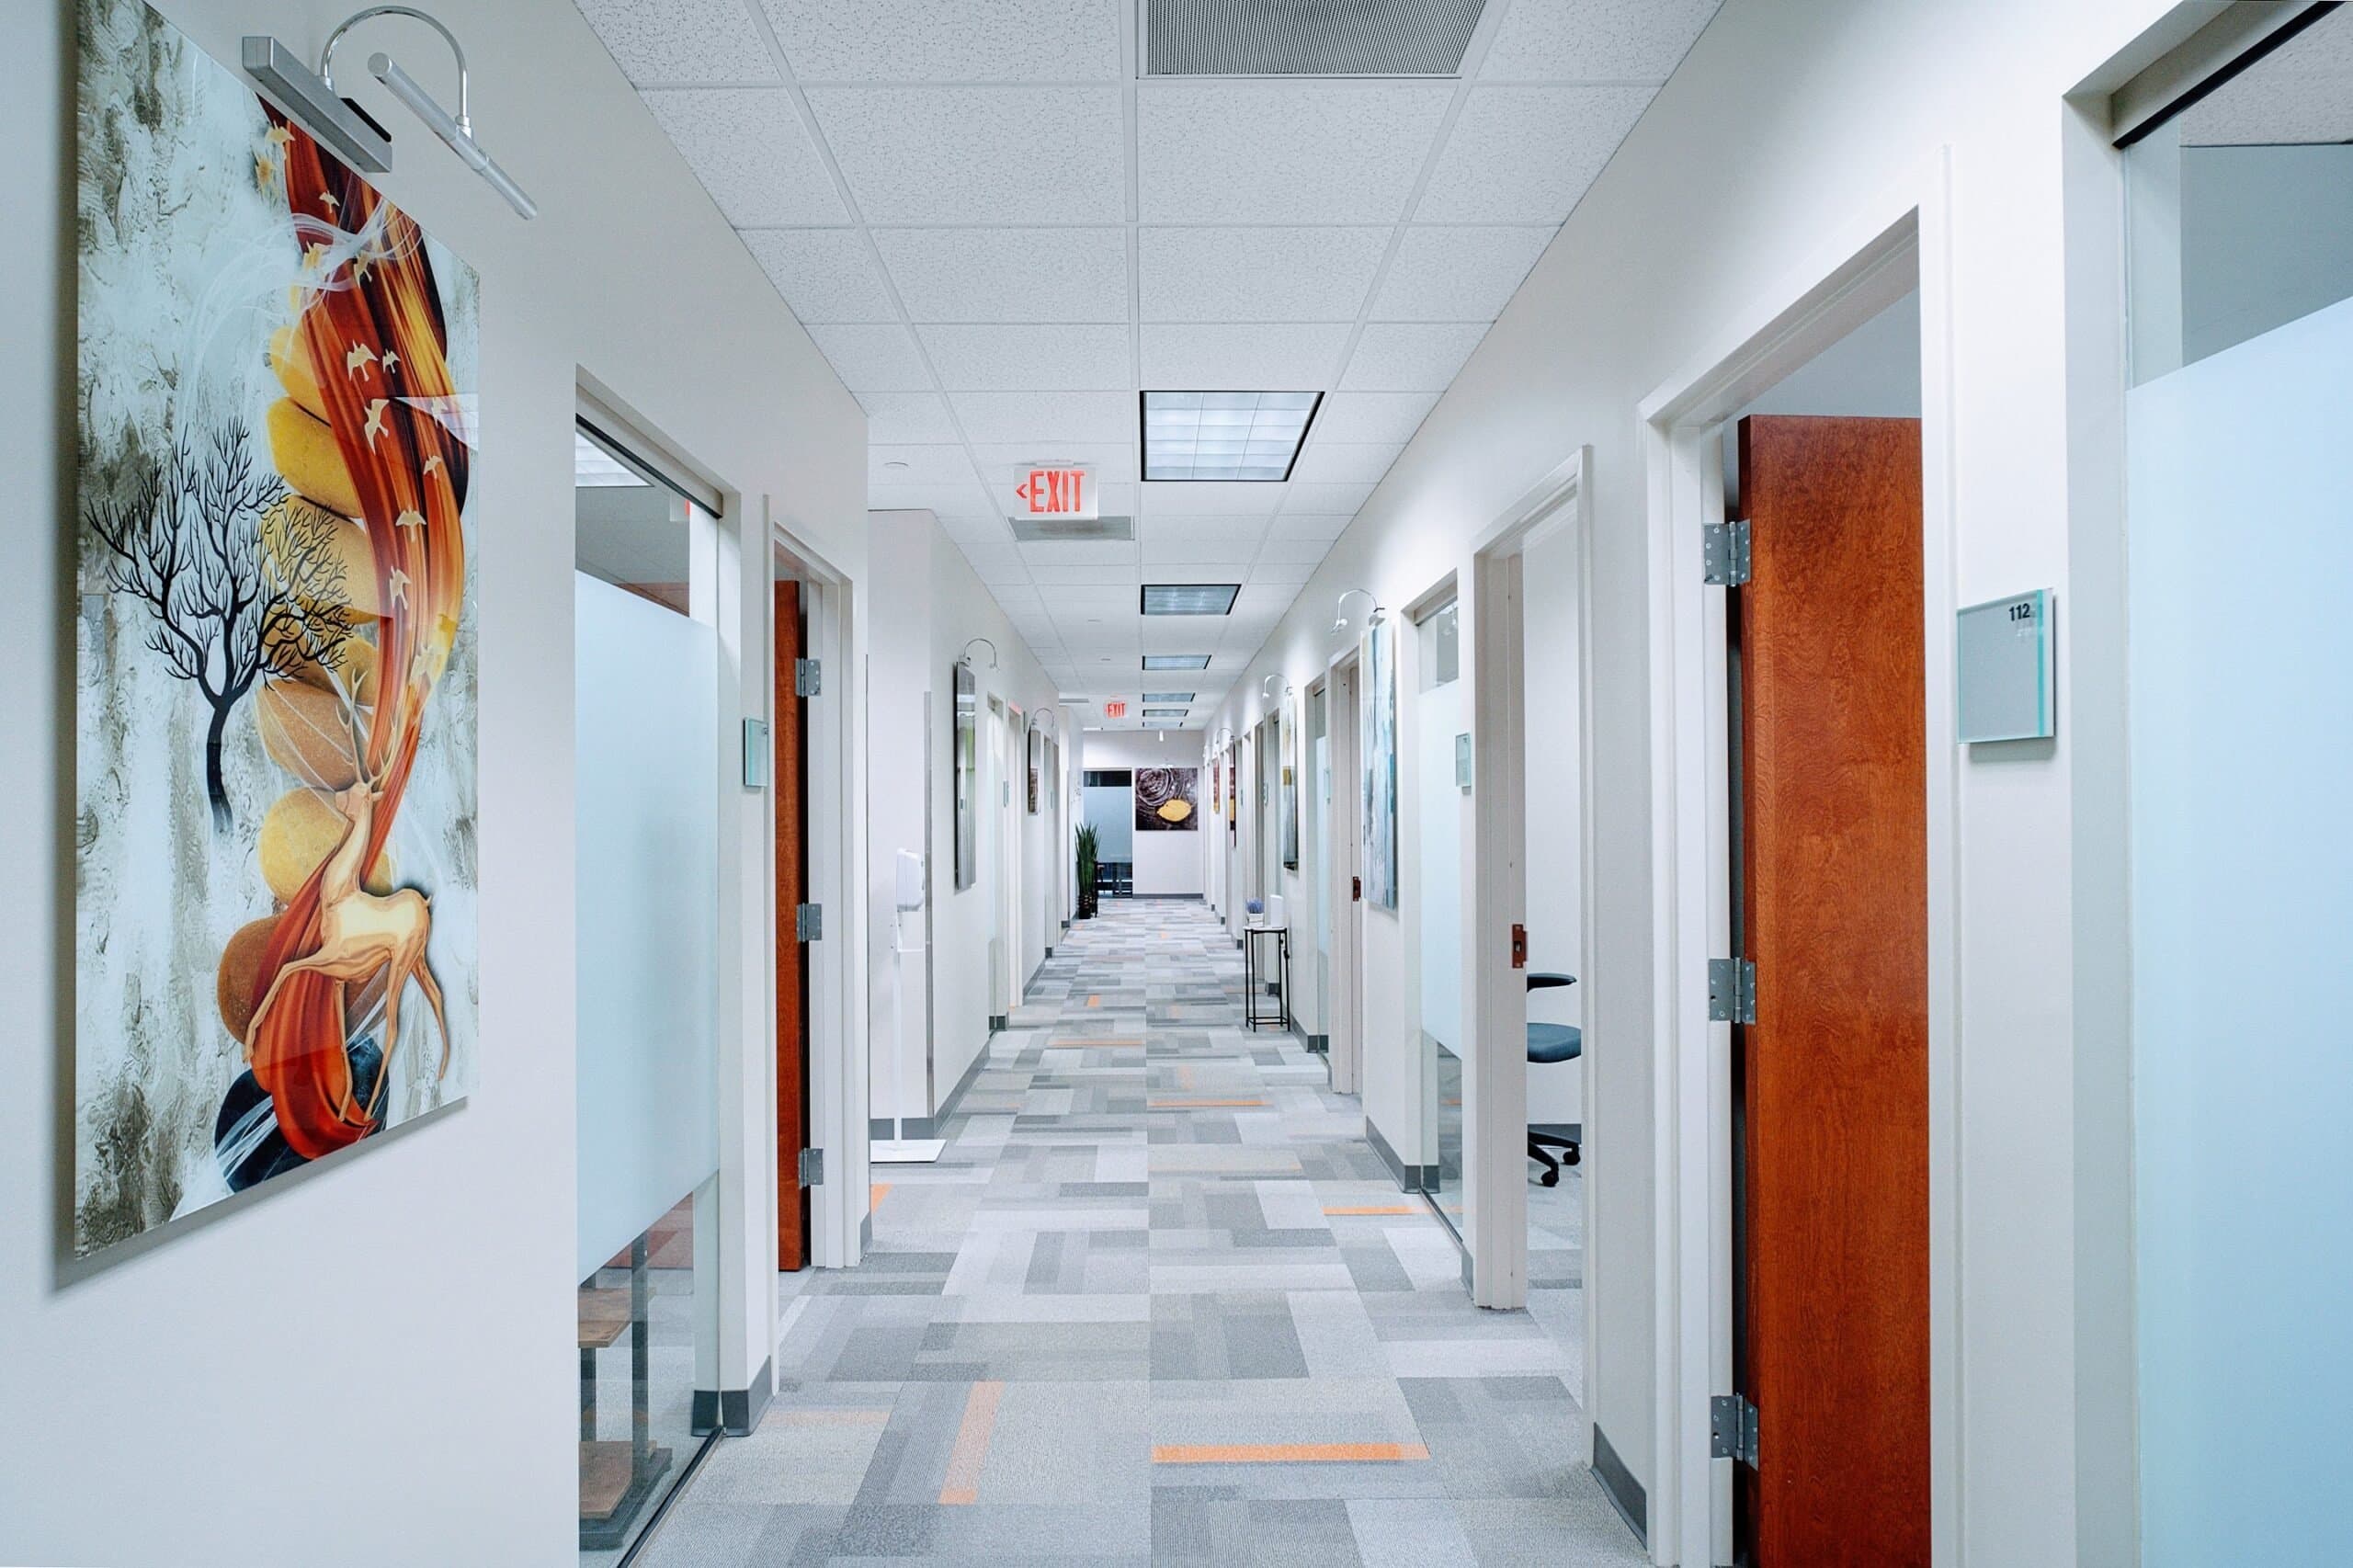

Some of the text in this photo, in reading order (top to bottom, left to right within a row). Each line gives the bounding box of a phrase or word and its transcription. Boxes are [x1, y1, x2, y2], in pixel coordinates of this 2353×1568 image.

[1029, 471, 1085, 512] EXIT
[2008, 603, 2030, 621] 112
[1108, 702, 1125, 717] EXIT
